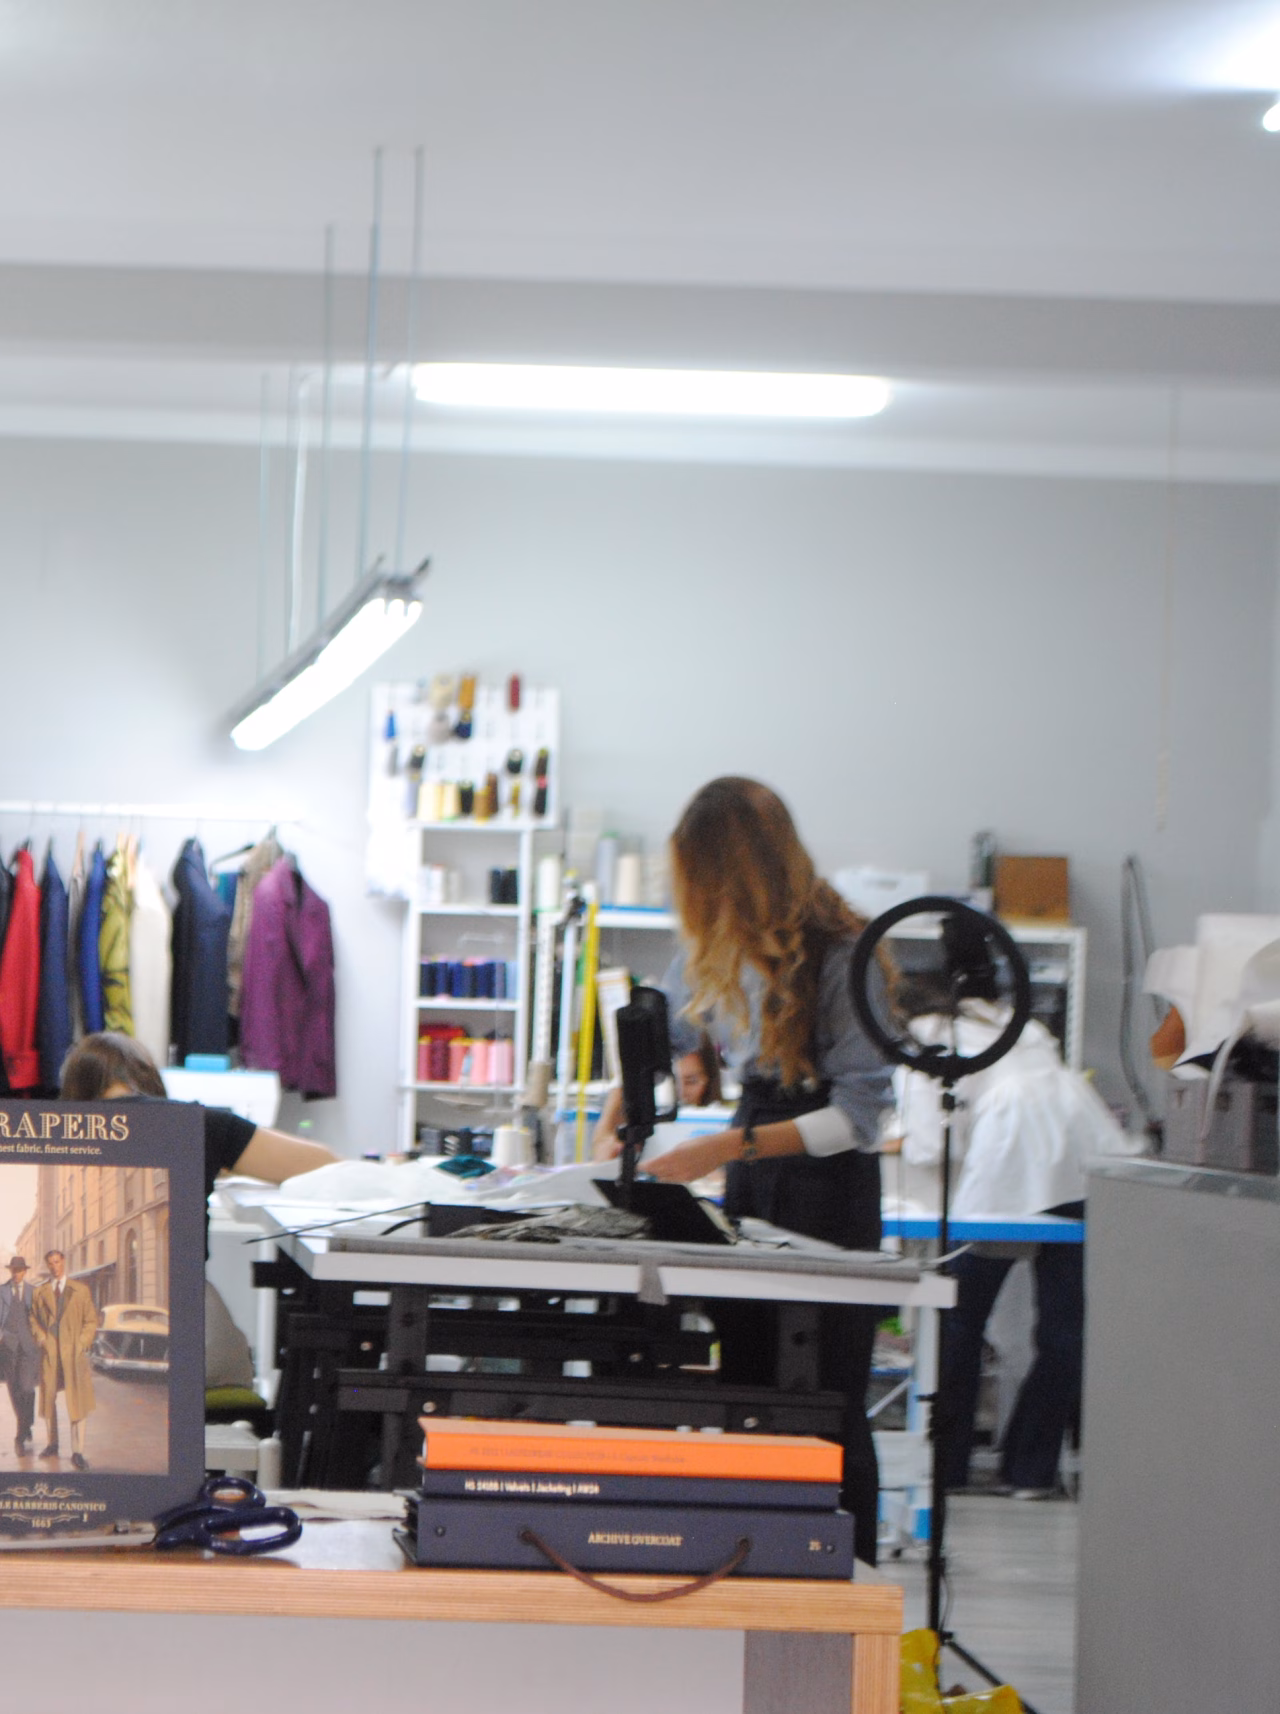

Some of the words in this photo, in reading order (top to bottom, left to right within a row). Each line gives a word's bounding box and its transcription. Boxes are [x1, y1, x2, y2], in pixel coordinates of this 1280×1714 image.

[44, 1144, 68, 1154] finest
[536, 1481, 572, 1496] Jacketing
[12, 1501, 58, 1510] BARBERIS
[58, 1502, 107, 1511] CANONICO
[587, 1531, 631, 1545] ARCHIVE
[631, 1533, 684, 1547] OVERCOAT
